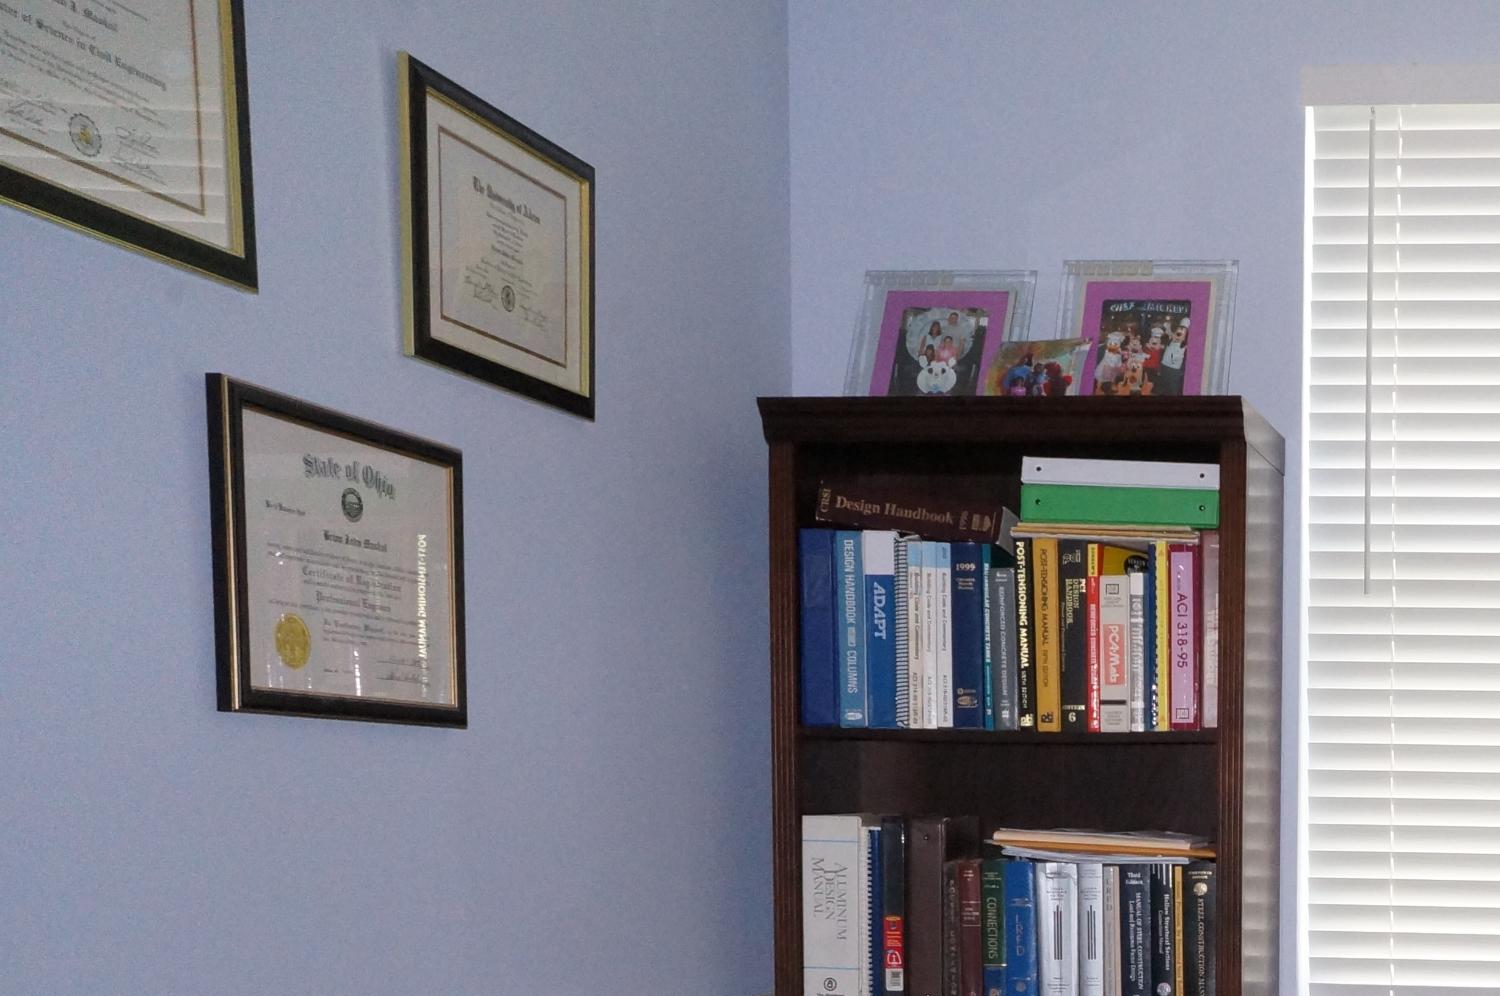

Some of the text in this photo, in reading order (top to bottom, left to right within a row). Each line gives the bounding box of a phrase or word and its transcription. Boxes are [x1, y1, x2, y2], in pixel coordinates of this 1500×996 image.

[834, 495, 882, 516] Design
[883, 502, 954, 525] Handbook
[843, 539, 855, 572] DESIGN
[955, 562, 976, 572] 1999
[844, 574, 857, 624] HANDBOOK
[1015, 541, 1028, 626] POST-TENSIONING
[873, 581, 887, 641] ADAPT
[1177, 592, 1188, 669] ACI 318-95
[846, 650, 859, 694] COLUMNS
[1019, 628, 1030, 669] MANUAL
[811, 857, 825, 917] MANUAL
[823, 868, 836, 920] DESIGN
[834, 862, 849, 941] ALUMINUM
[986, 897, 999, 960] CONNECTIONS
